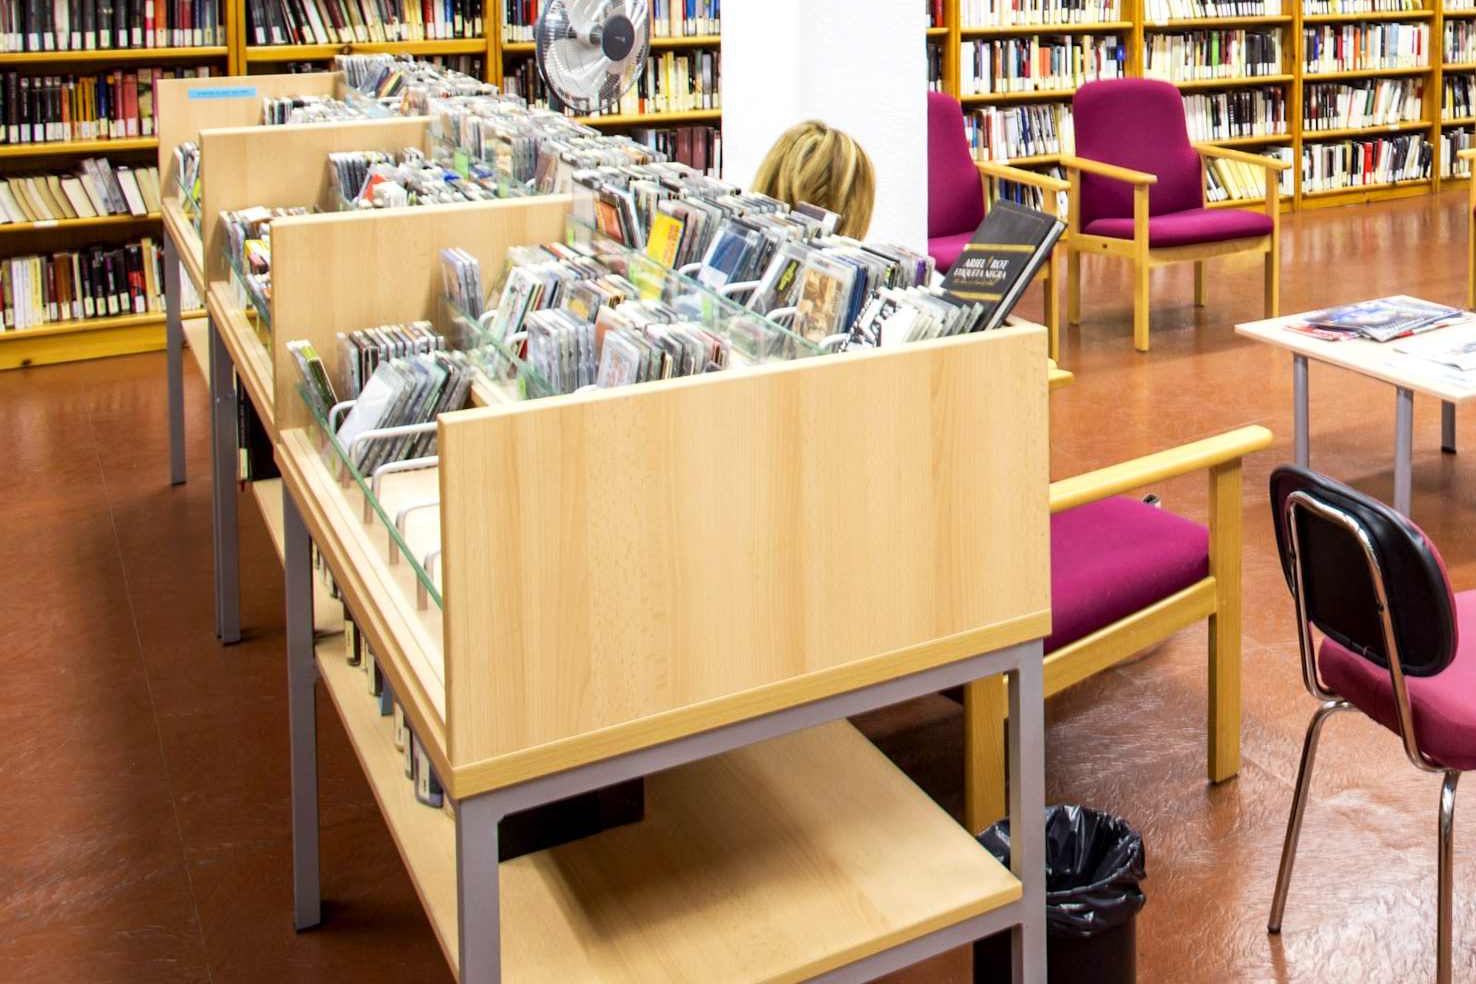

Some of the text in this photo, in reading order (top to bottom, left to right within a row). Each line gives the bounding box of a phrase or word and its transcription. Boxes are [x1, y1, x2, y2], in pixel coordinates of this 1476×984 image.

[963, 257, 1010, 270] ARIEL ROT
[953, 267, 1007, 281] ETIQUETA NEGRA
